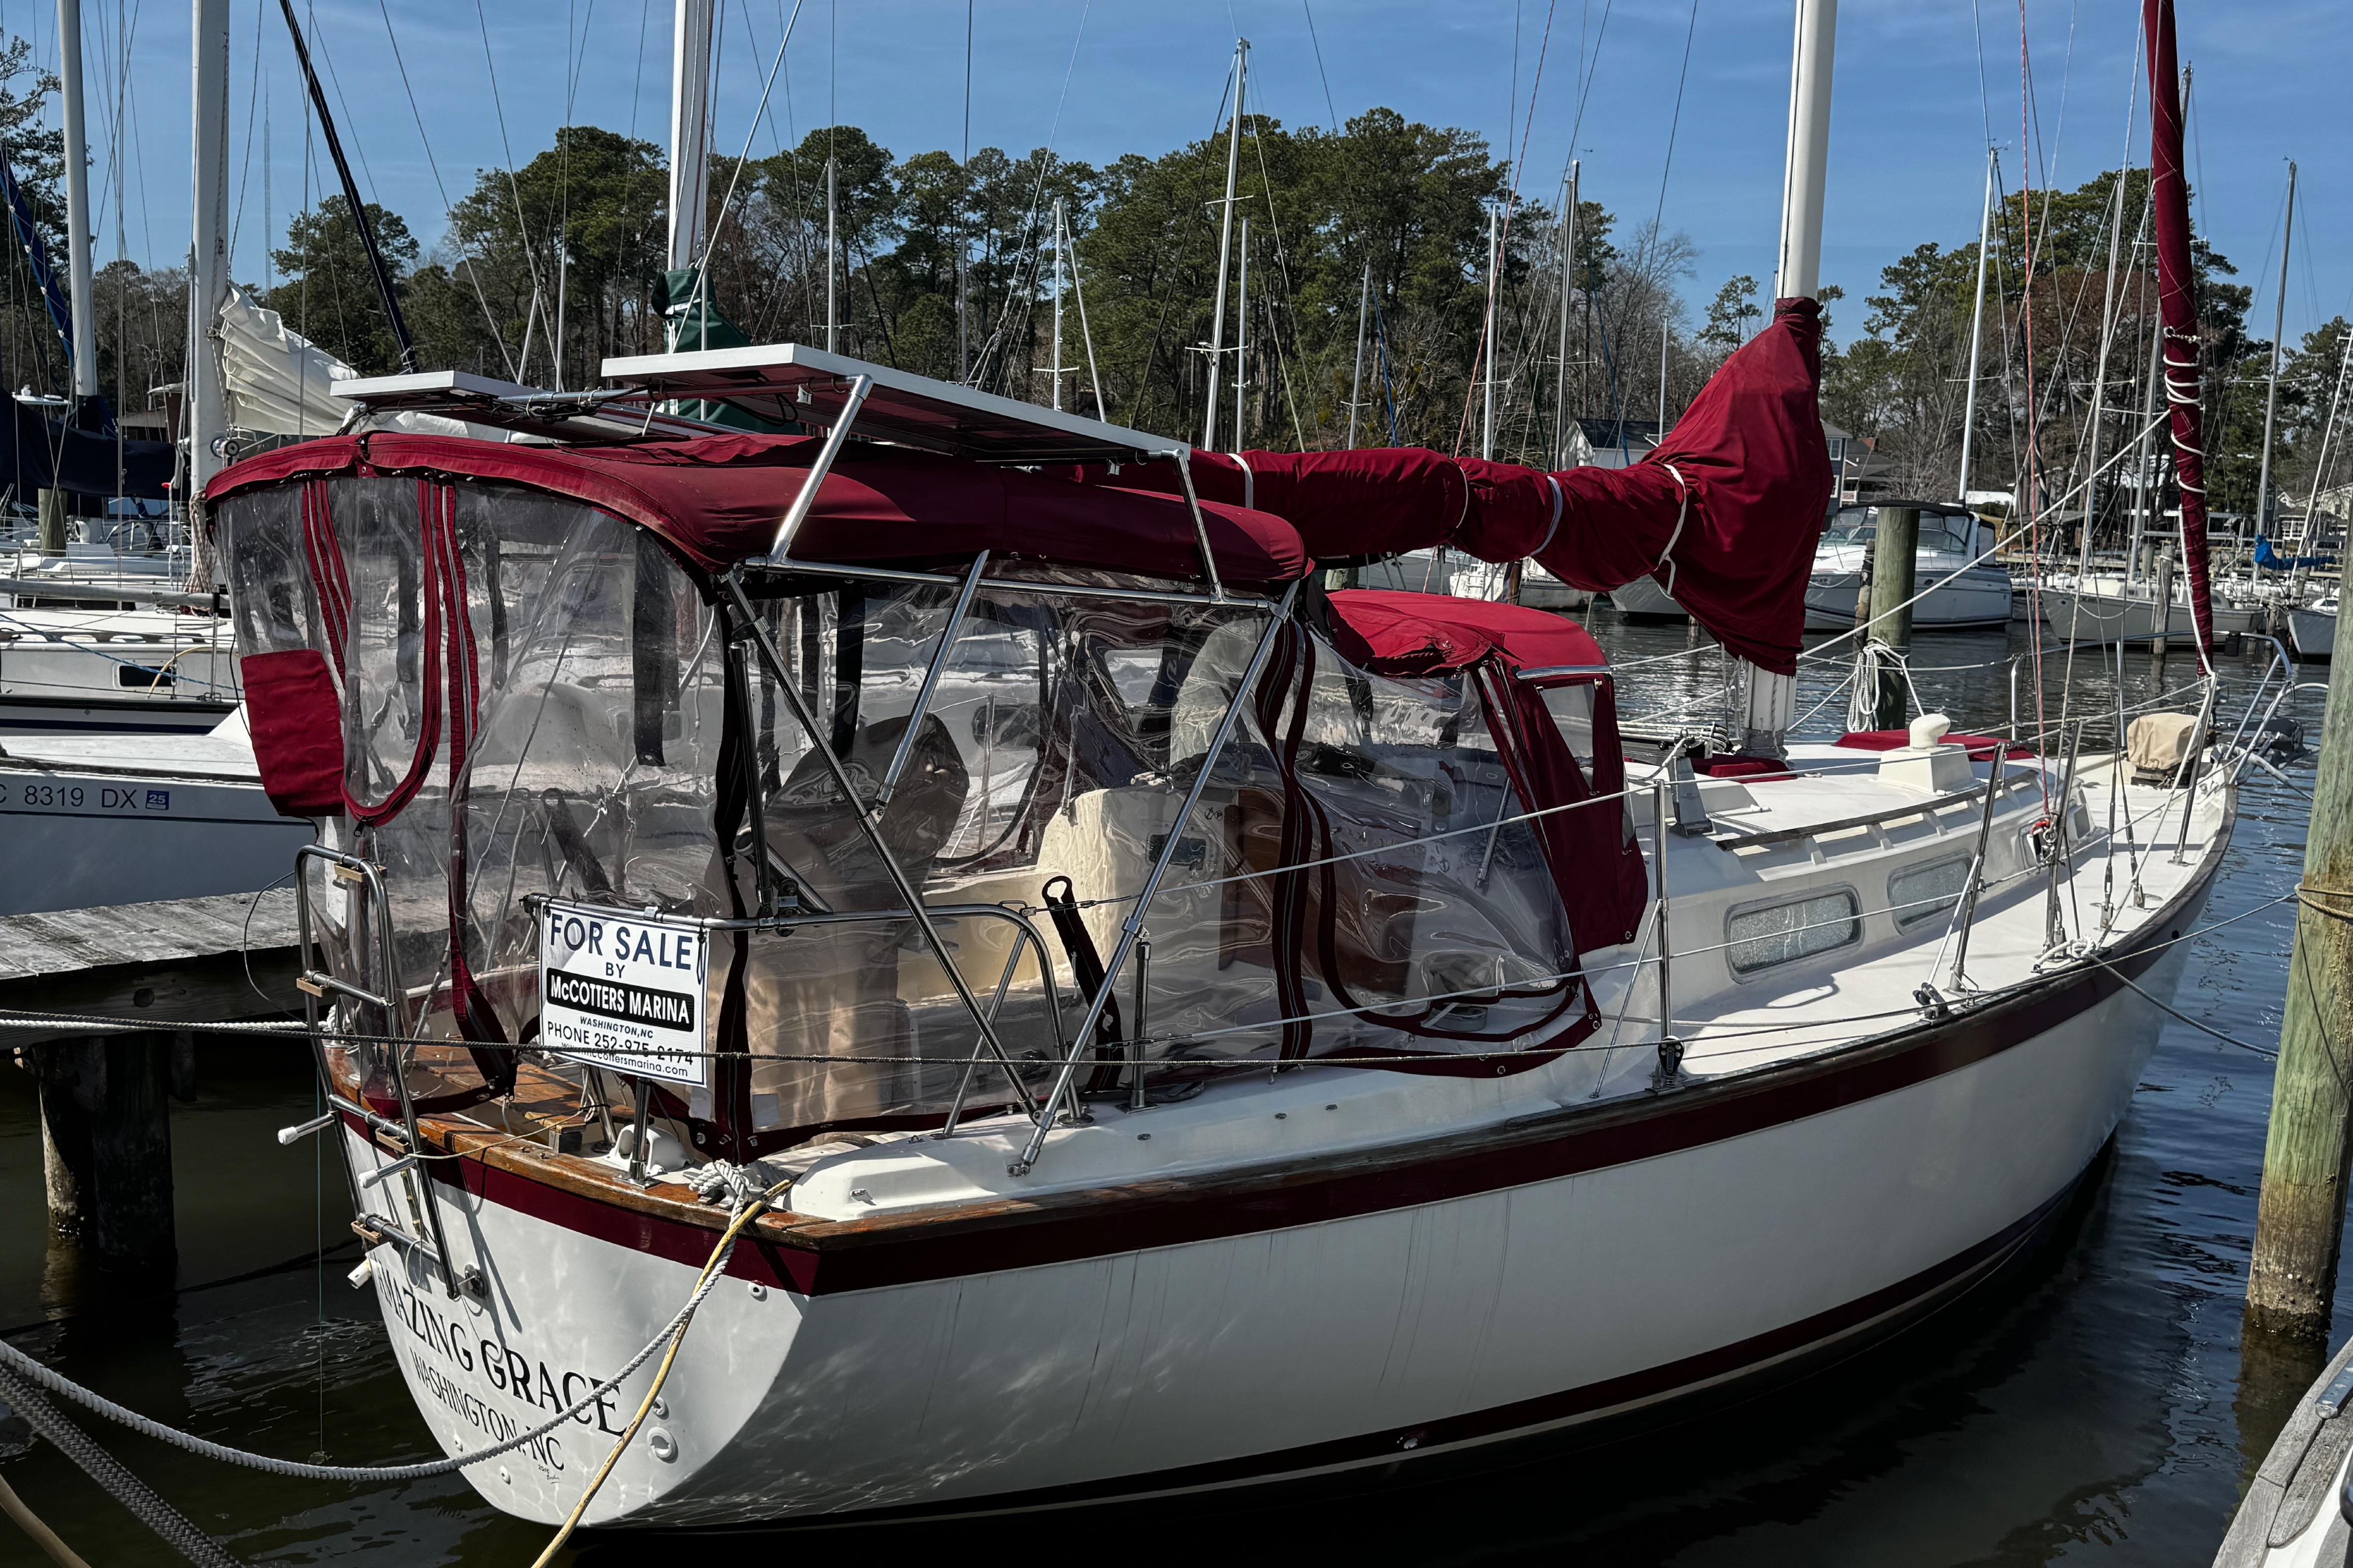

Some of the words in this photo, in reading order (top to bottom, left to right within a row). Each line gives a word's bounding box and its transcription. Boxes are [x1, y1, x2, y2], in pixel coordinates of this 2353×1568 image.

[25, 785, 84, 807] 8319
[102, 788, 137, 809] DX
[149, 794, 166, 804] 25
[550, 913, 603, 956] FOR
[615, 926, 693, 970] SALE
[606, 962, 625, 978] BY
[551, 975, 624, 1012] McCOTTERS
[629, 991, 690, 1024] MARINA
[547, 1021, 590, 1045] PHONE
[594, 1033, 693, 1065] 252-9752174
[481, 1340, 627, 1437] GRACE
[525, 1426, 564, 1470] NC
